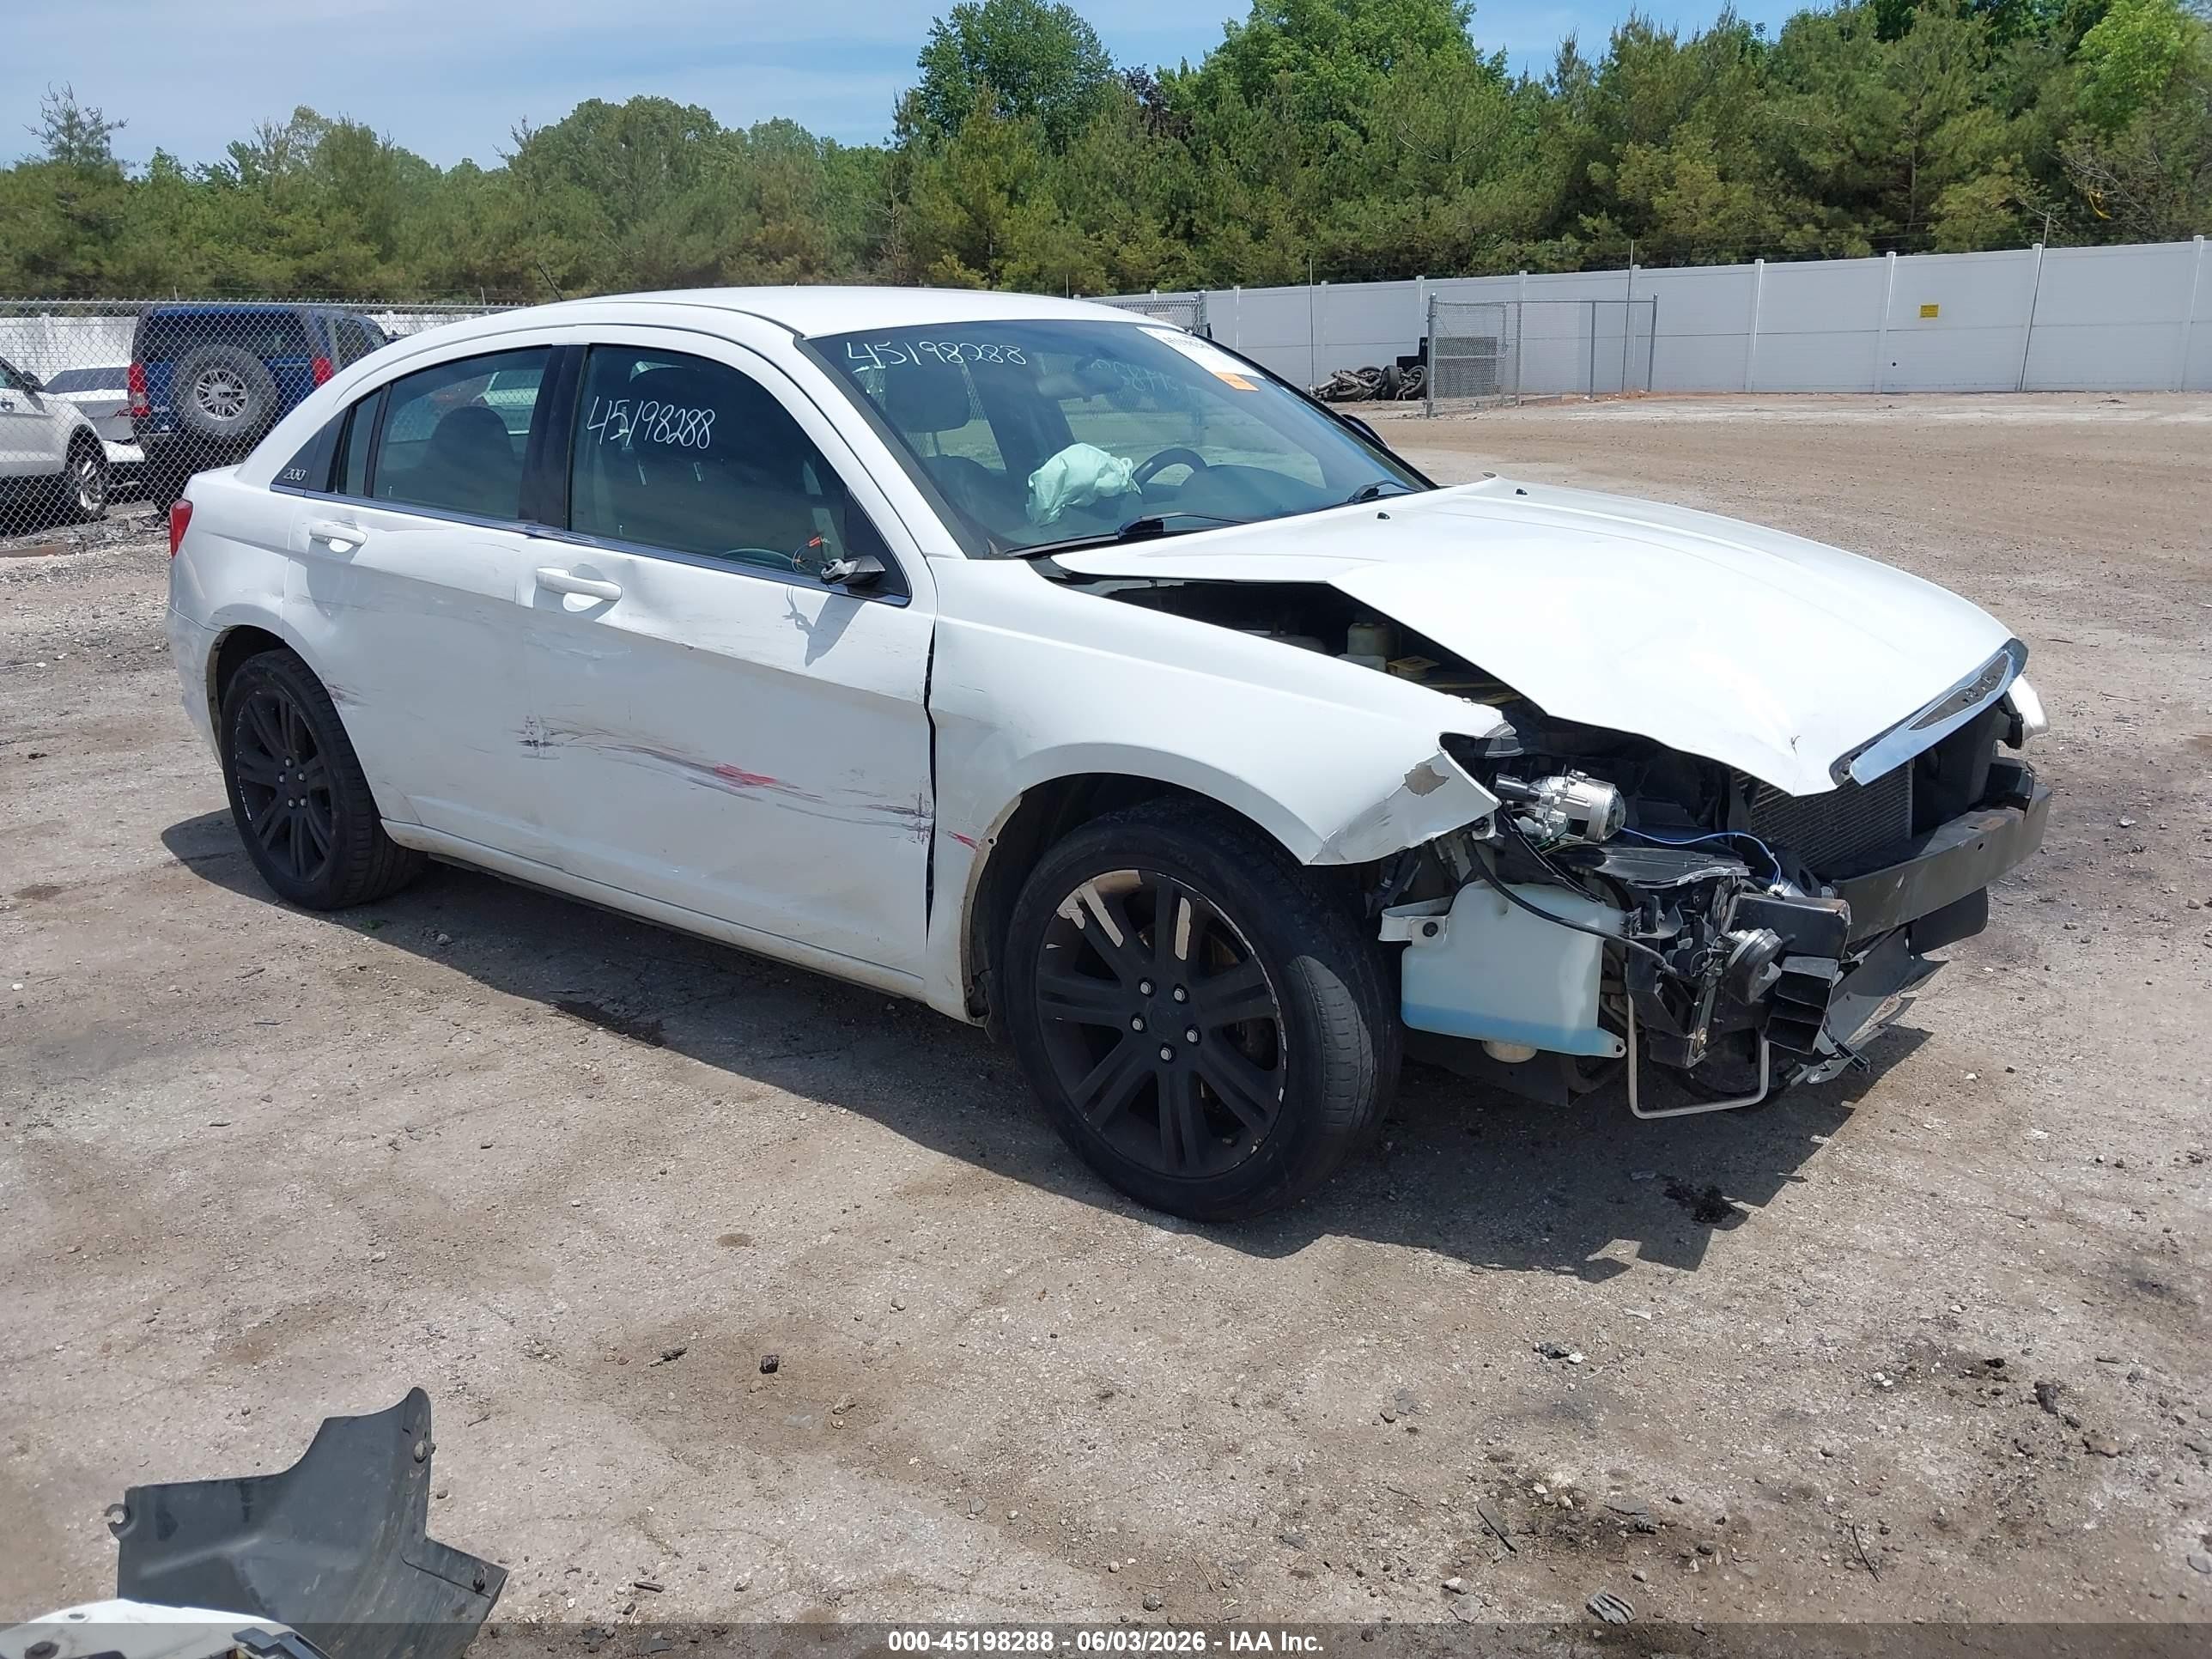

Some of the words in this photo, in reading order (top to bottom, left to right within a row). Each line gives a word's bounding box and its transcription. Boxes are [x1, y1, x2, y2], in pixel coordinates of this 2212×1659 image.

[845, 341, 1026, 367] 45198288
[586, 395, 716, 450] 45198288
[283, 468, 307, 481] 200
